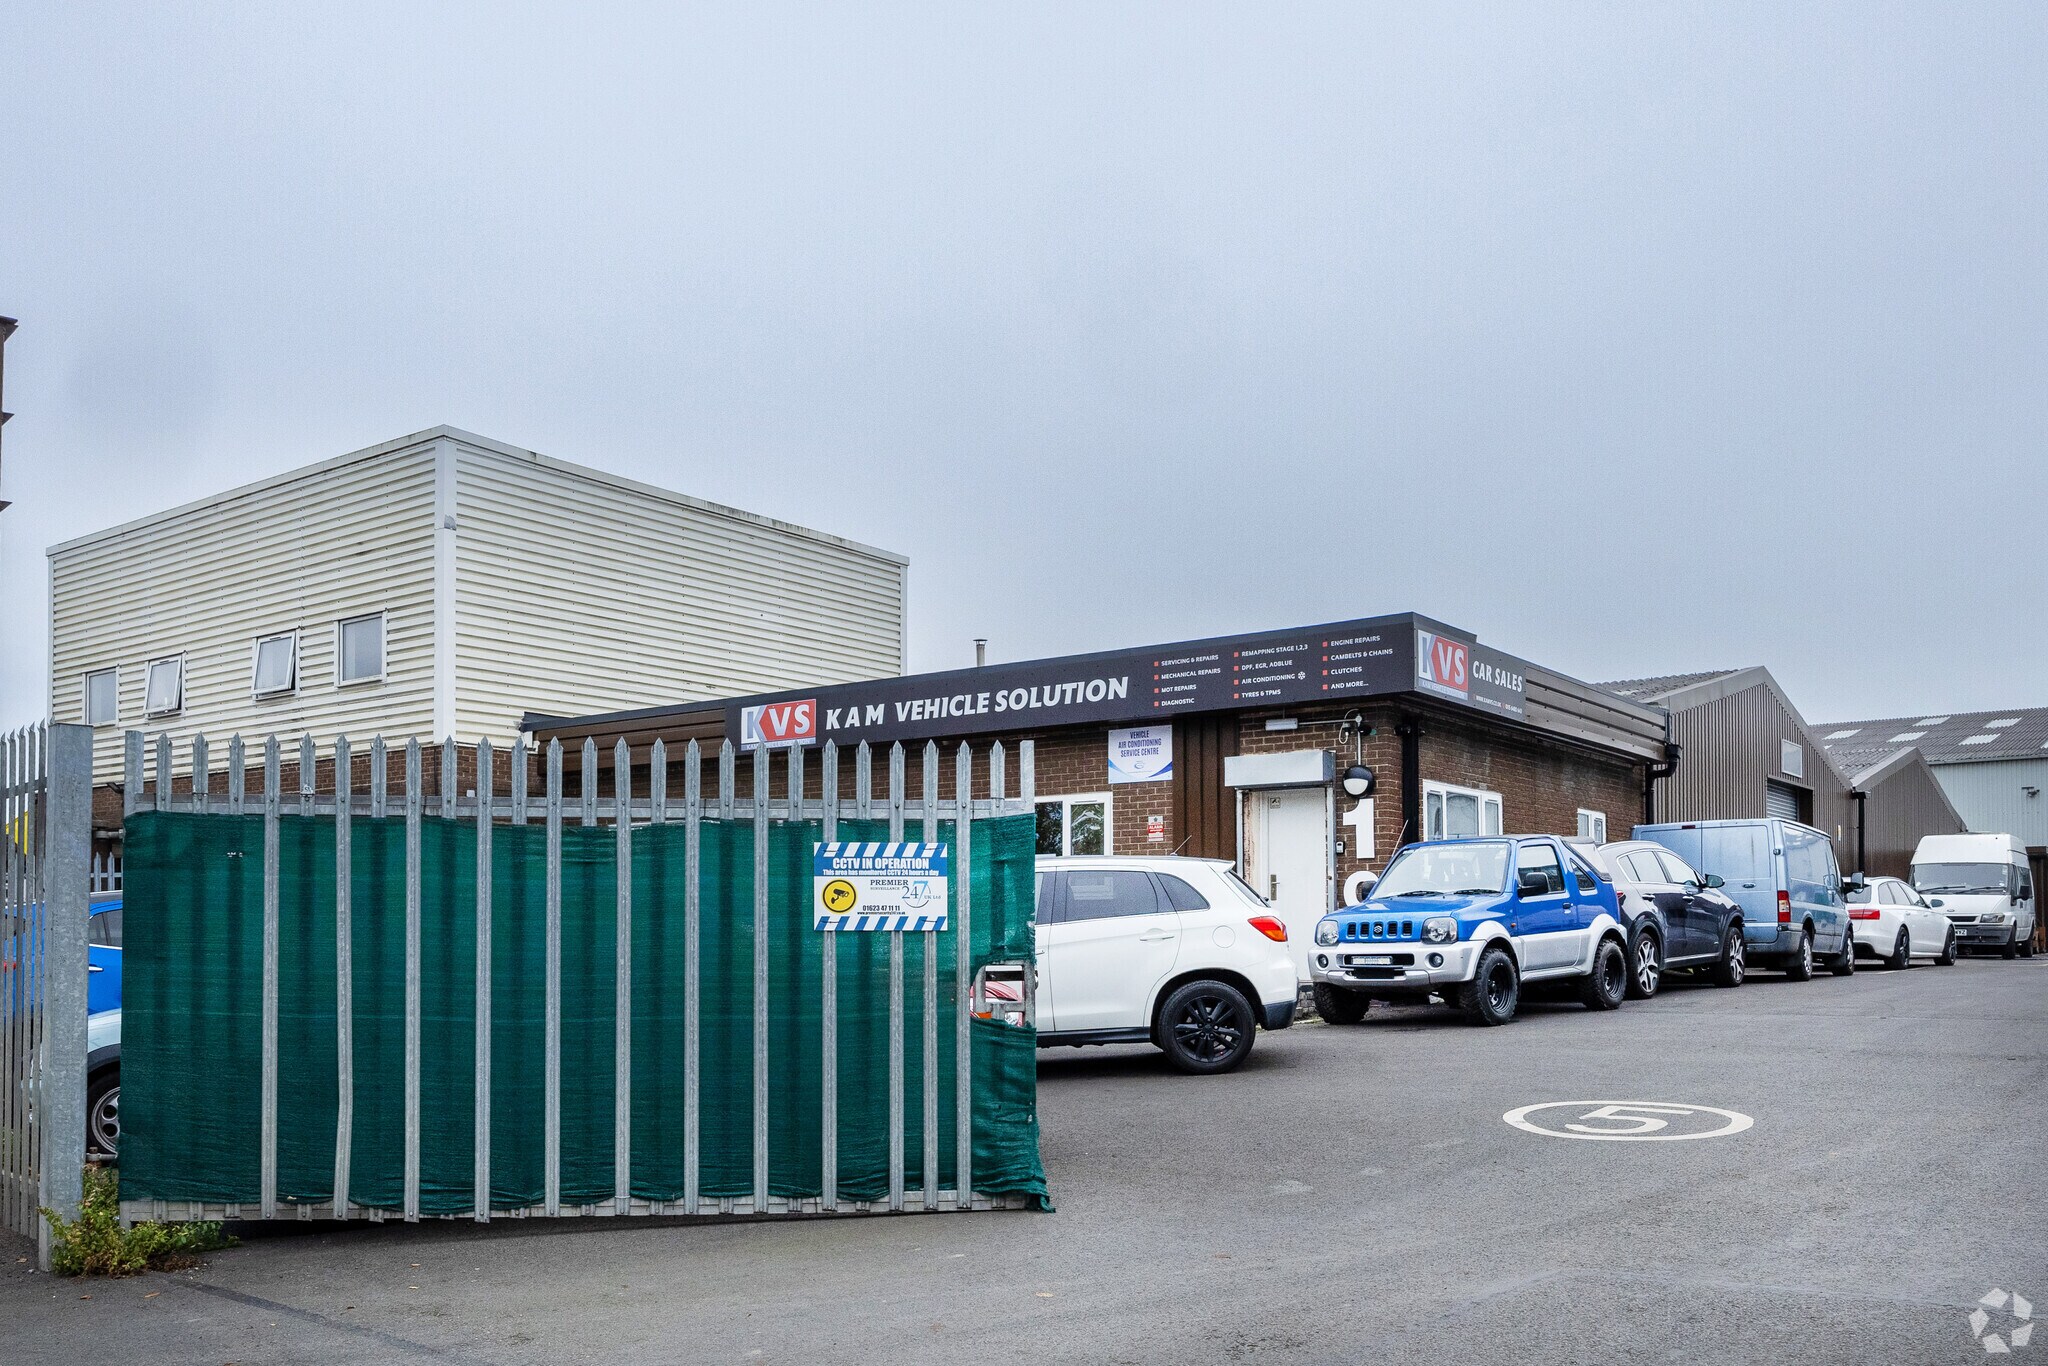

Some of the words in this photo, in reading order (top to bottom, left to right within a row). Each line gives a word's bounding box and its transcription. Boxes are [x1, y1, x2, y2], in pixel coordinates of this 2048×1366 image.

[1242, 648, 1275, 656] REMAPPING
[1331, 652, 1362, 660] CAMBELTS
[1161, 658, 1190, 666] SERVICING
[1422, 634, 1465, 685] KVS
[1161, 671, 1197, 679] MECHANICAL
[1331, 666, 1362, 675] CLUTCHES
[1253, 674, 1295, 683] CONDITIONING
[1472, 660, 1492, 682] CAR
[1494, 668, 1522, 692] SALES
[826, 704, 884, 730] KAM
[895, 692, 990, 722] VEHICLE
[994, 676, 1129, 712] SOLUTION
[1162, 698, 1194, 706] DIAGNOSTIC
[745, 704, 810, 743] KVS
[1130, 730, 1149, 739] VEHICLE
[1128, 738, 1161, 748] CONDITIONING
[1120, 749, 1140, 757] SERVICE
[1141, 747, 1159, 755] CENTRE
[1343, 798, 1375, 859] 1
[832, 858, 860, 869] CCTV
[862, 858, 872, 869] IN
[874, 858, 929, 869] OPERATION
[1564, 1105, 1694, 1134] 5
